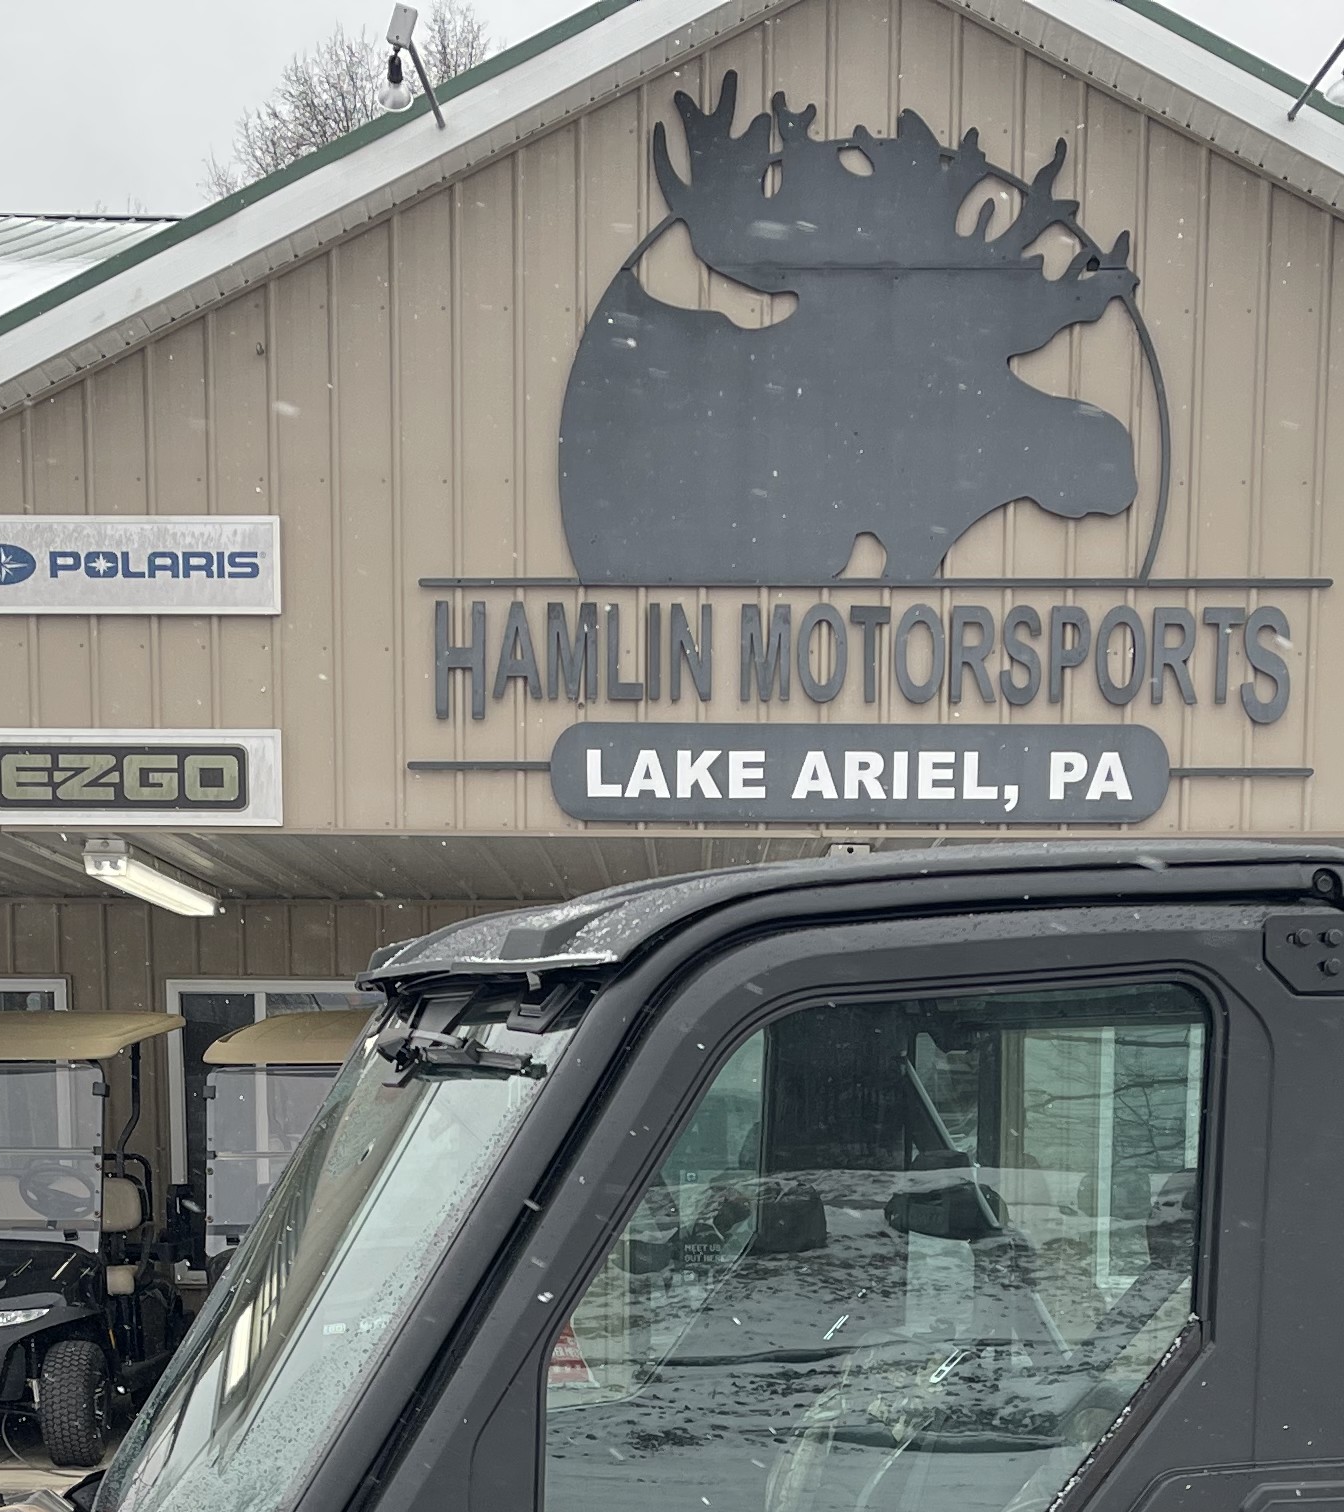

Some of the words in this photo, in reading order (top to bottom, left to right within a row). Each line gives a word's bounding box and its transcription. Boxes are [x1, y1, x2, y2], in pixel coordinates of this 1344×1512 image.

[49, 550, 260, 579] POLARIS
[434, 600, 713, 721] HAMLIN
[739, 603, 1291, 725] MOTORSPORTS
[0, 753, 240, 801] EZGO
[586, 748, 765, 800] LAKE
[791, 749, 1020, 813] ARIEL,
[1049, 750, 1133, 801] PA
